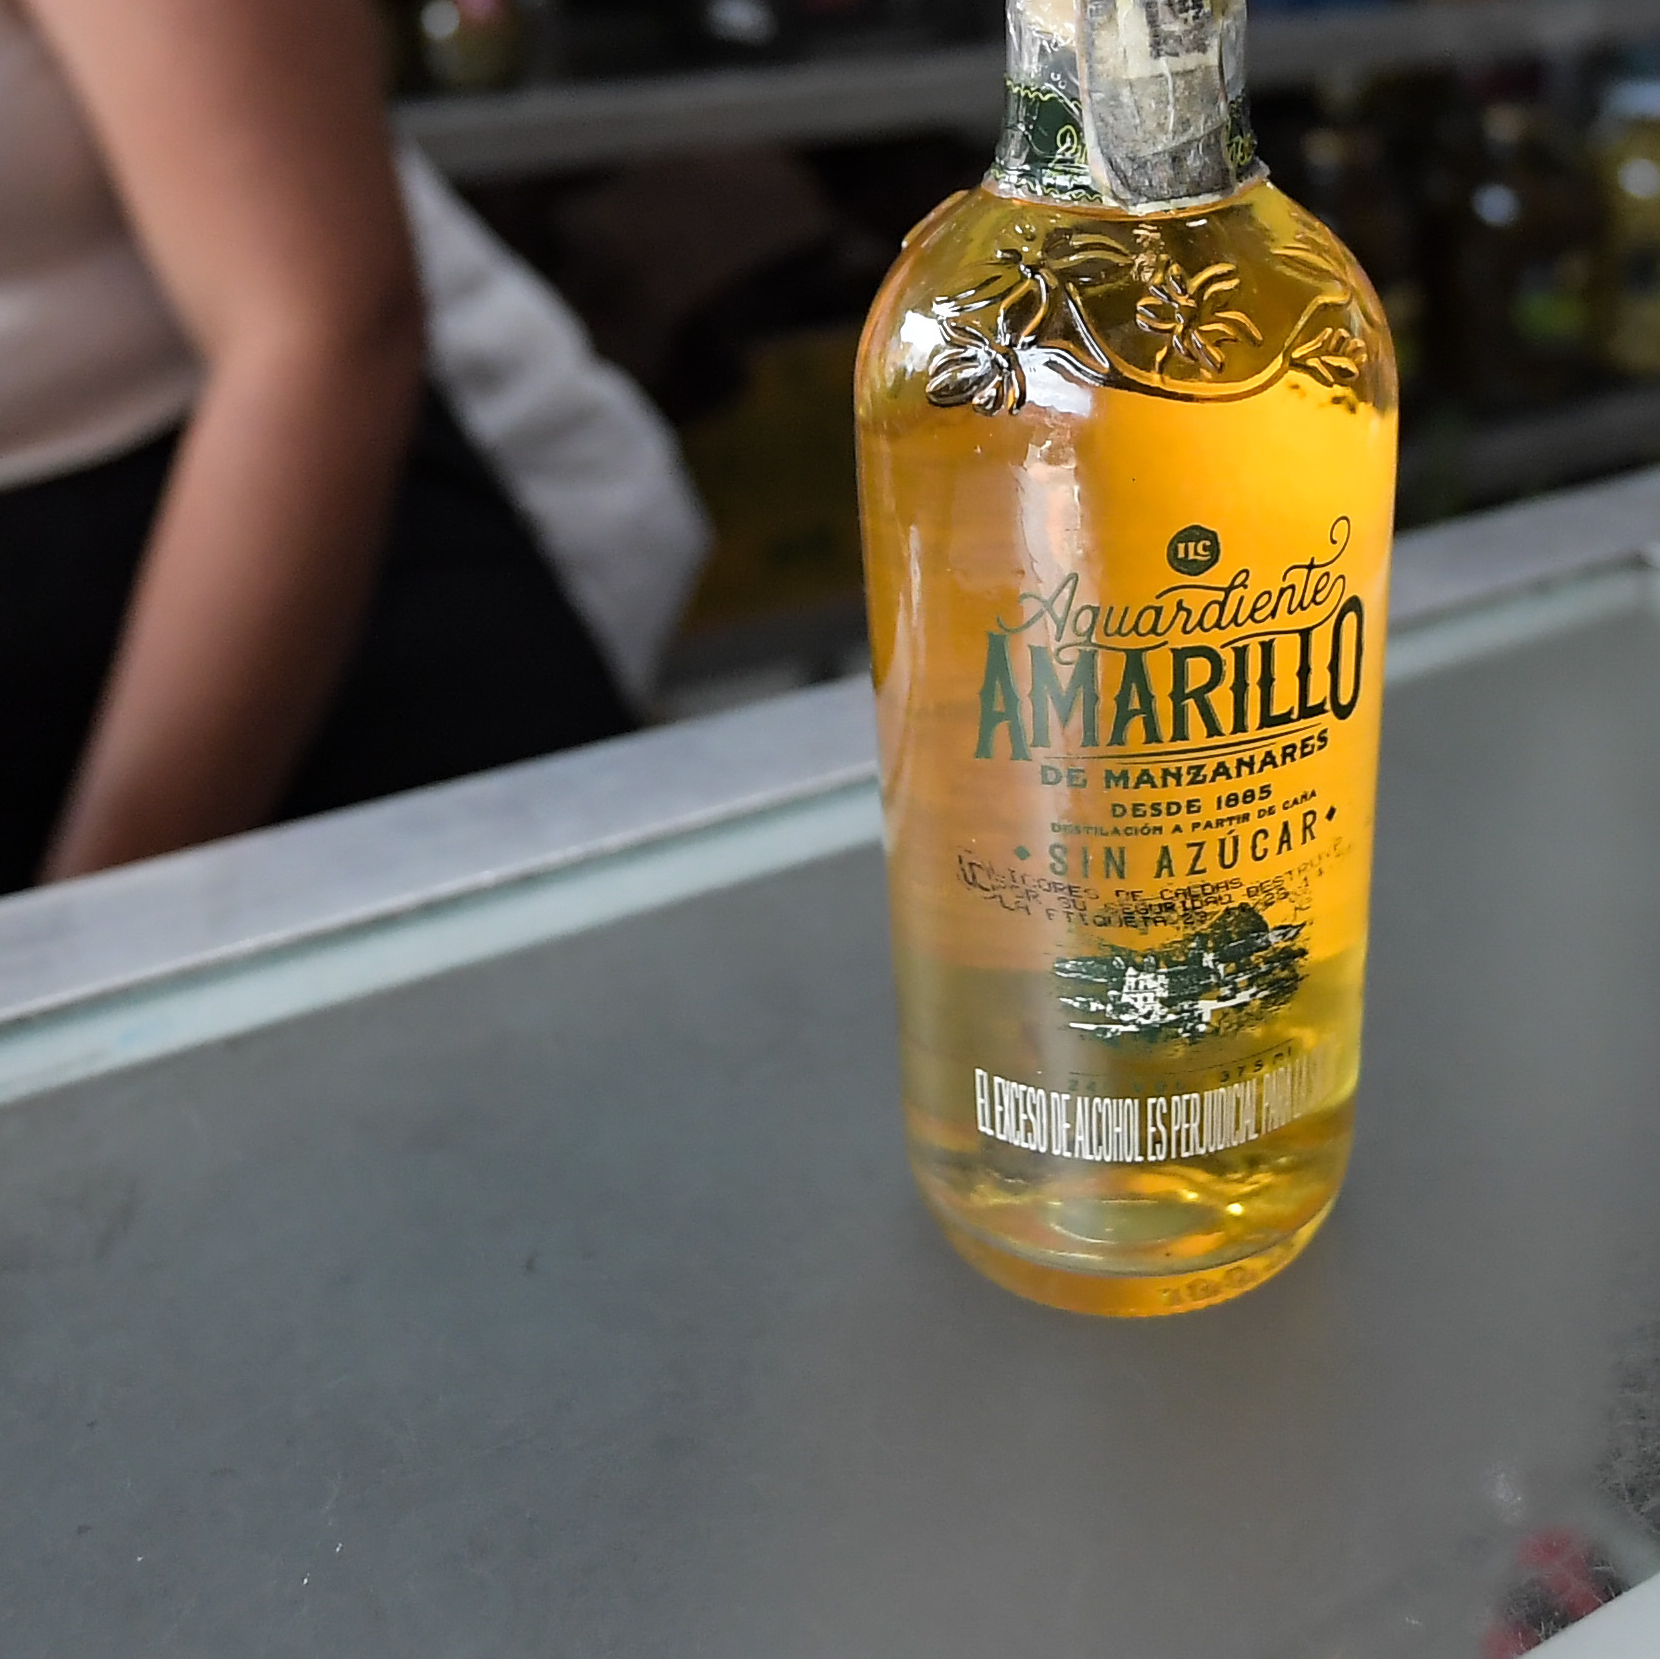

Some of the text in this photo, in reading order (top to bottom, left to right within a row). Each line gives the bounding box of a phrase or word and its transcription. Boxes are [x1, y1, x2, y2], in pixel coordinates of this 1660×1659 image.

[998, 516, 1350, 665] Aguardiente
[974, 594, 1364, 761] AMARILLO
[1040, 727, 1330, 790] DE MANZANARES
[1050, 788, 1318, 838] DESTILACIÓN A PARTIR DE CAÑA
[1110, 783, 1273, 819] DESDE 1885
[1047, 844, 1127, 879] SIN
[1153, 808, 1319, 879] AZÚCAR
[974, 1067, 994, 1136] EL
[993, 1075, 1047, 1154] EXCESO
[1049, 1091, 1073, 1158] DE
[1073, 1094, 1144, 1163] ALCOHOL
[1146, 1095, 1167, 1163] ES
[1170, 1077, 1258, 1161] PERJUDICIAL
